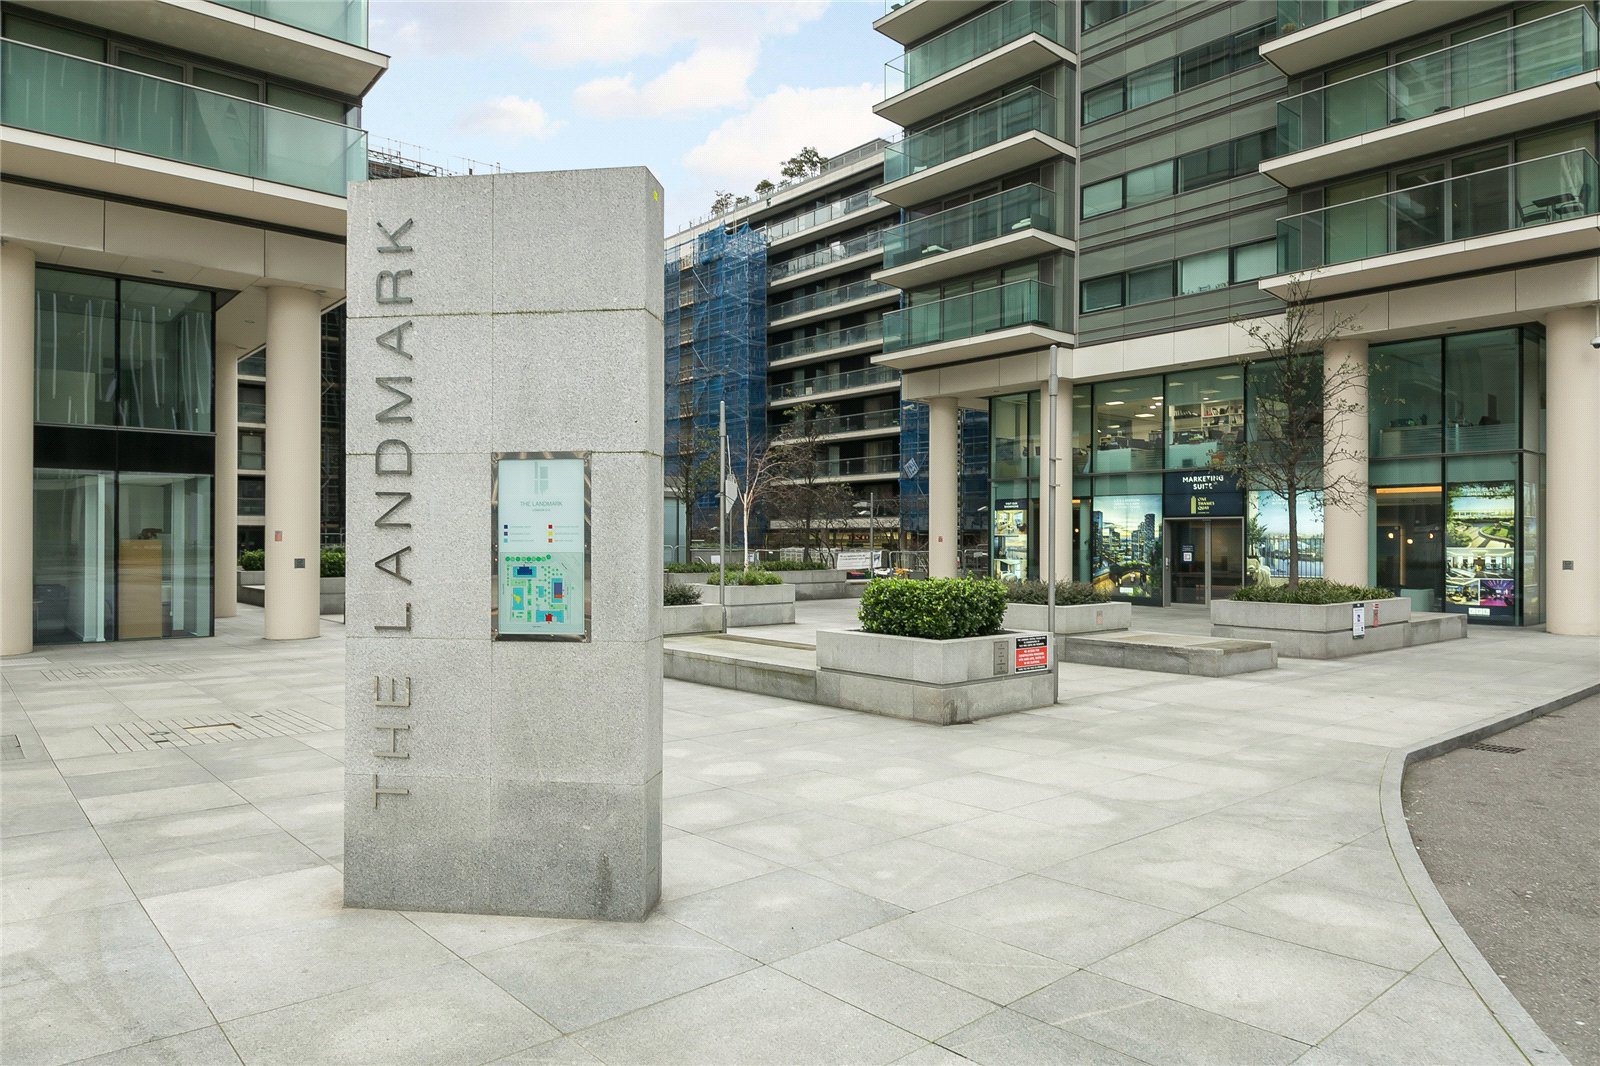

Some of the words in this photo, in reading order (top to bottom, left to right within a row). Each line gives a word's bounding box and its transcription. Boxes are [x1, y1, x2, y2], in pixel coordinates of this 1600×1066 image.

[374, 218, 414, 632] LANDMARK
[1182, 475, 1224, 483] MARKETING
[373, 676, 412, 810] THE
